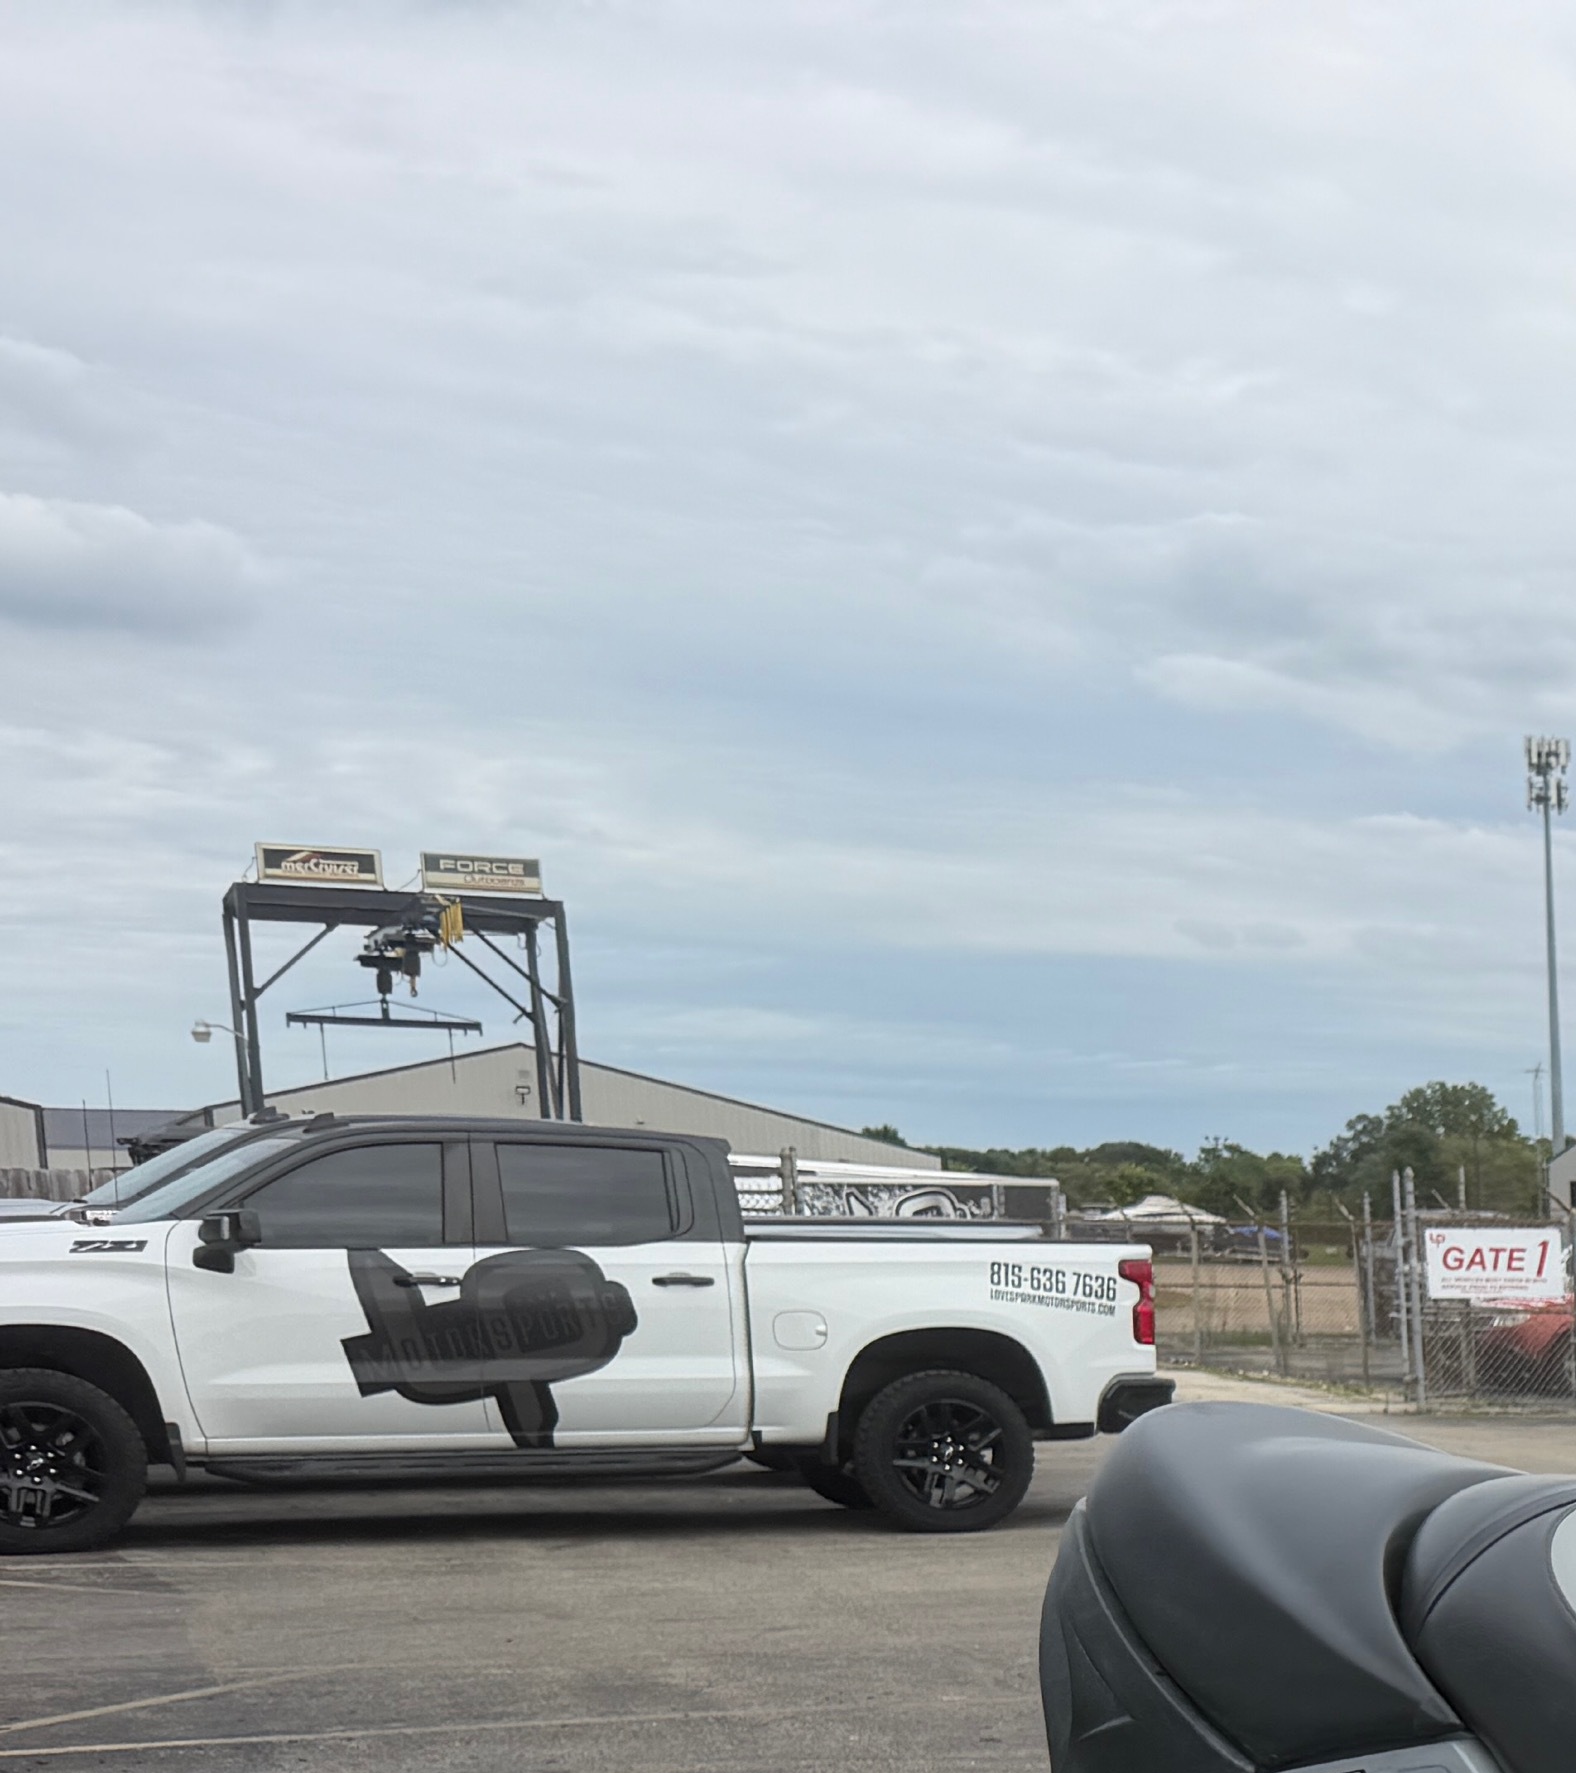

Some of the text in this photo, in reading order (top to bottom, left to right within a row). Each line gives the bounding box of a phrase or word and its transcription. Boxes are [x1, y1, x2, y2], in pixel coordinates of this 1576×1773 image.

[440, 859, 524, 875] FORCE
[1442, 1240, 1549, 1277] GATE 1
[990, 1261, 1117, 1302] 815-636 7636
